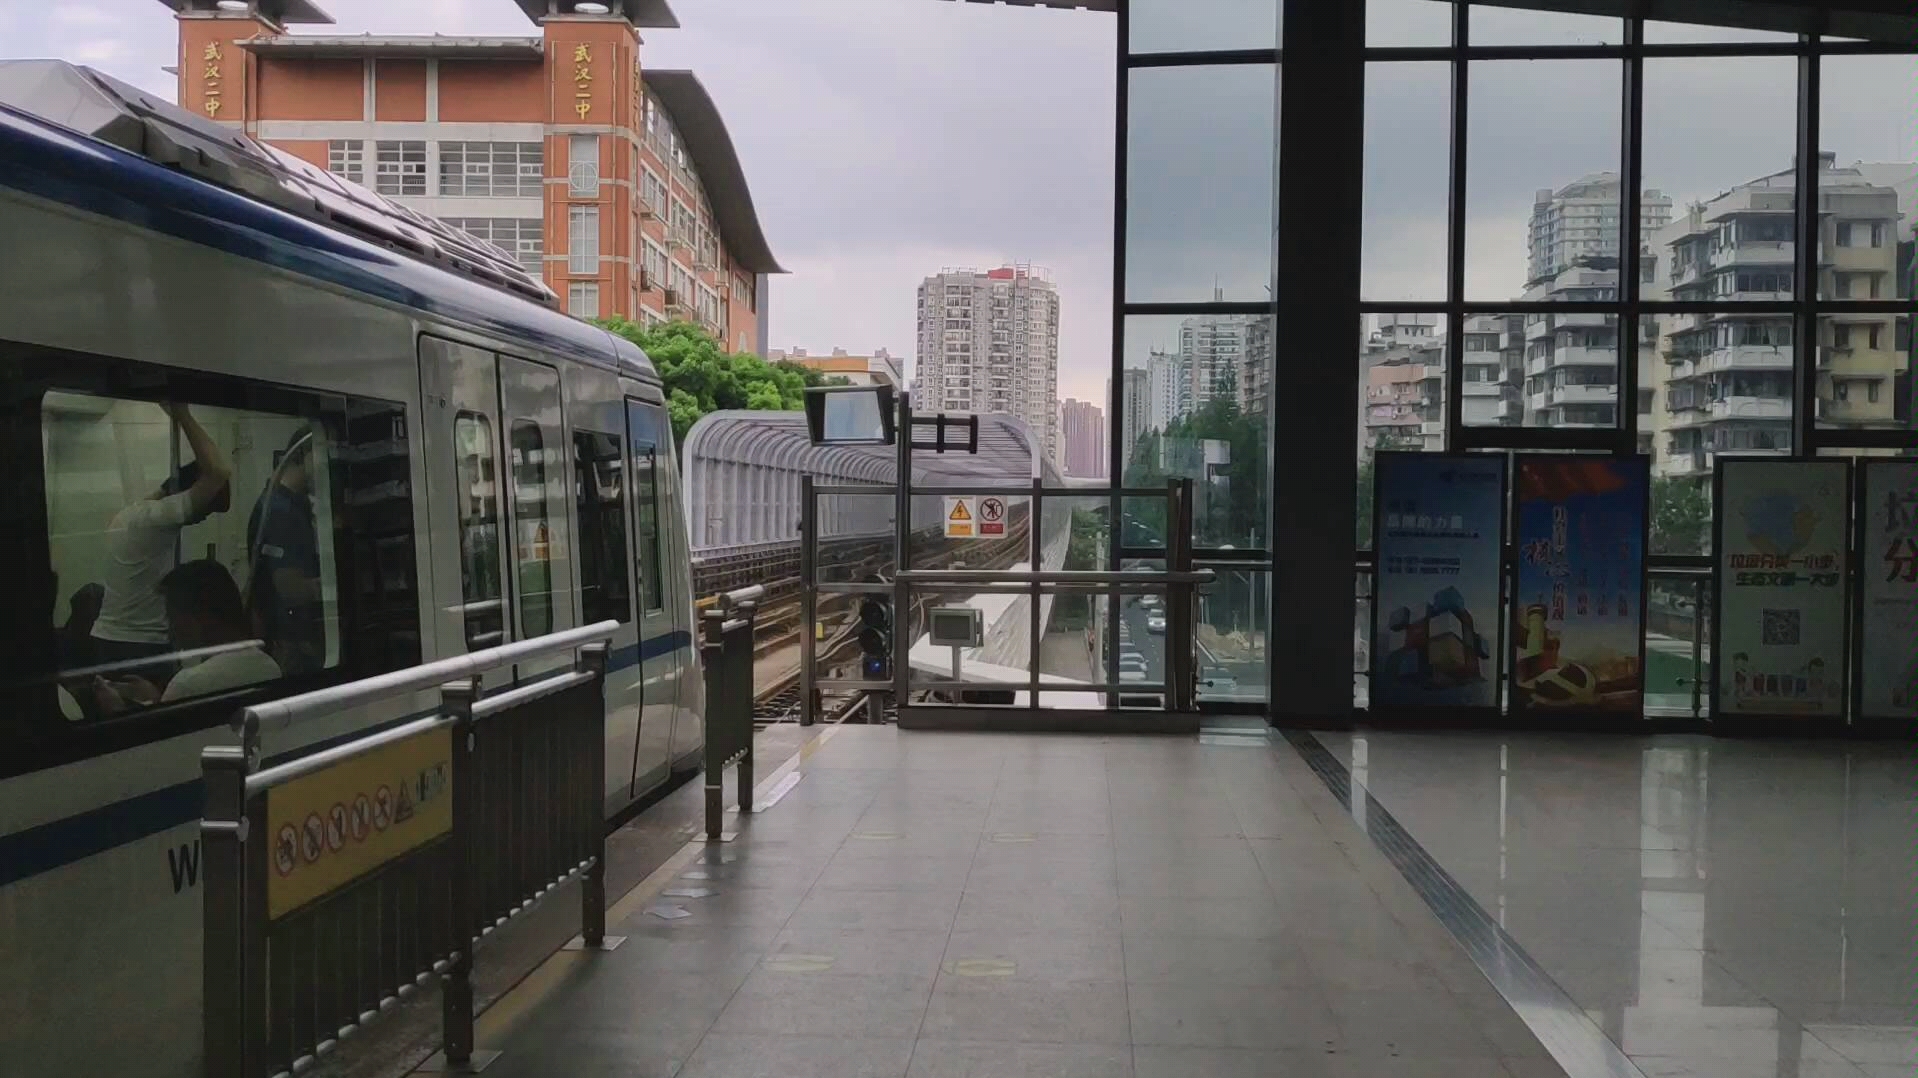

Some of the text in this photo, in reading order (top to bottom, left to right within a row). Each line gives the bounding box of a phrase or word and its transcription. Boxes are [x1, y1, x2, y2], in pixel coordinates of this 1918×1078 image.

[204, 42, 223, 118] 武汉二中
[573, 42, 593, 120] 武汉二中
